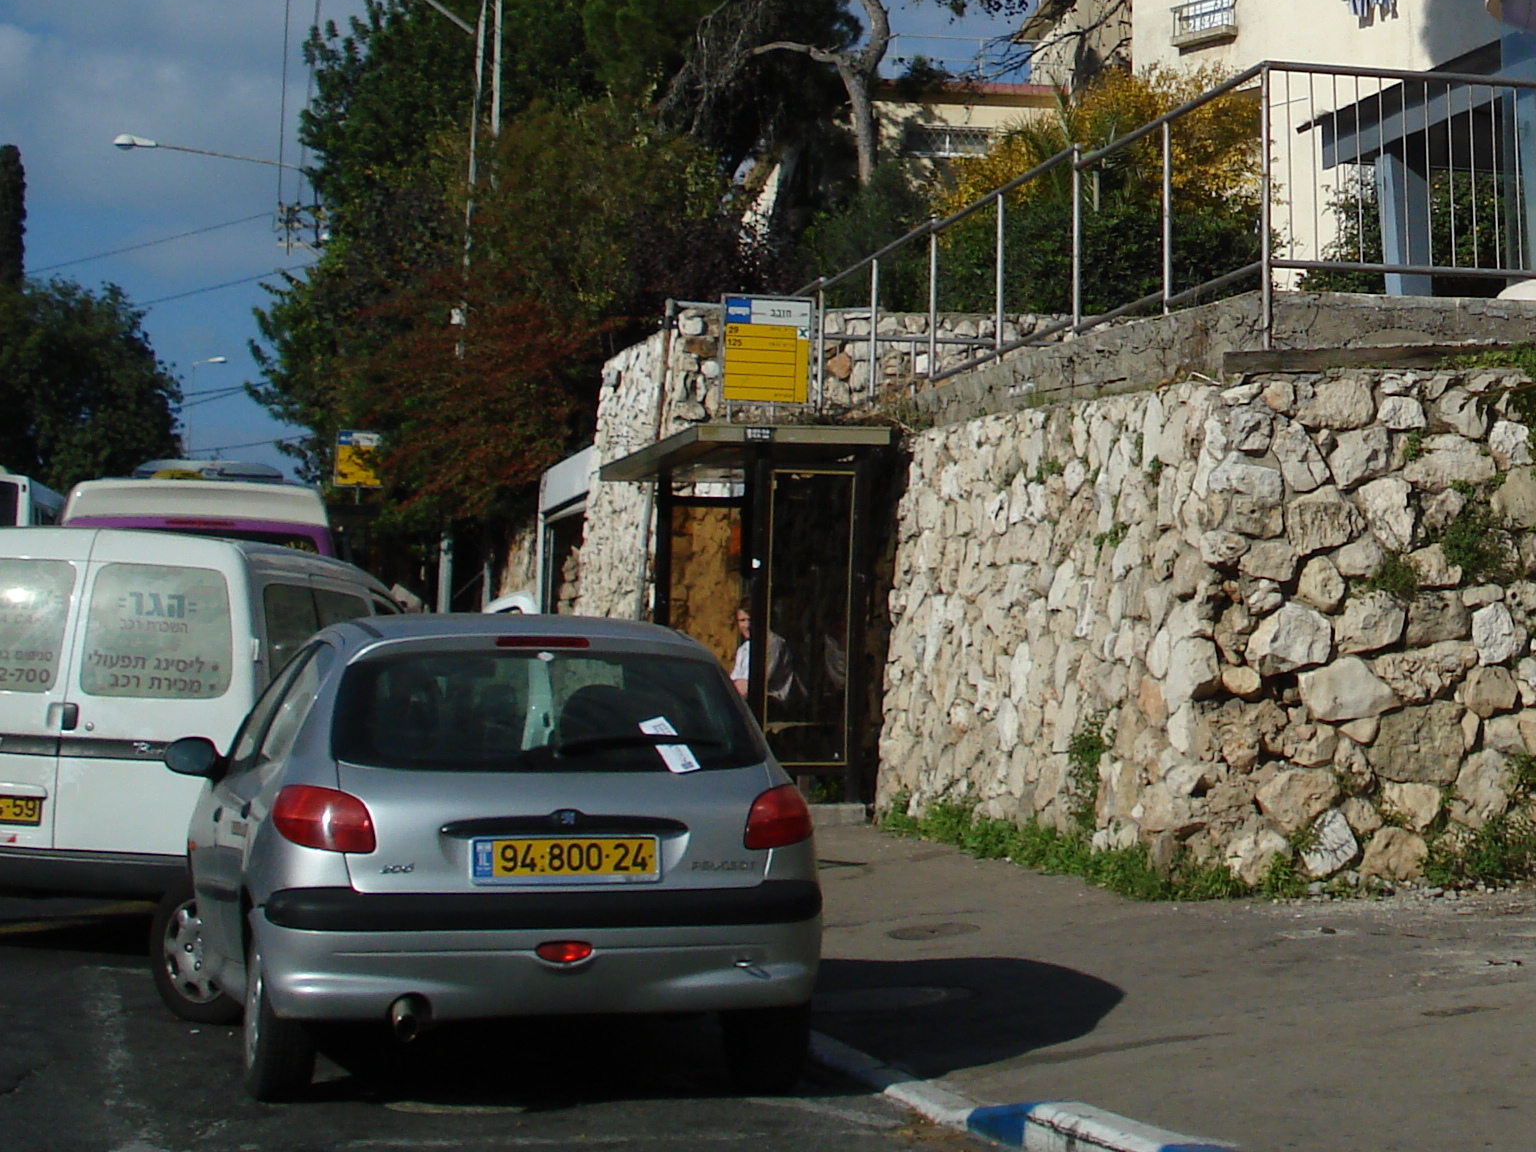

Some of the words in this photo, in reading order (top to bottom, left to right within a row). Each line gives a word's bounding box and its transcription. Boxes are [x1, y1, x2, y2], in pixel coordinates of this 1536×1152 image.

[728, 326, 739, 334] 29
[727, 338, 743, 347] 125
[88, 649, 147, 670] תפעולי
[153, 655, 205, 674] ליסינג
[110, 673, 141, 689] רכב
[149, 676, 202, 694] מכירת
